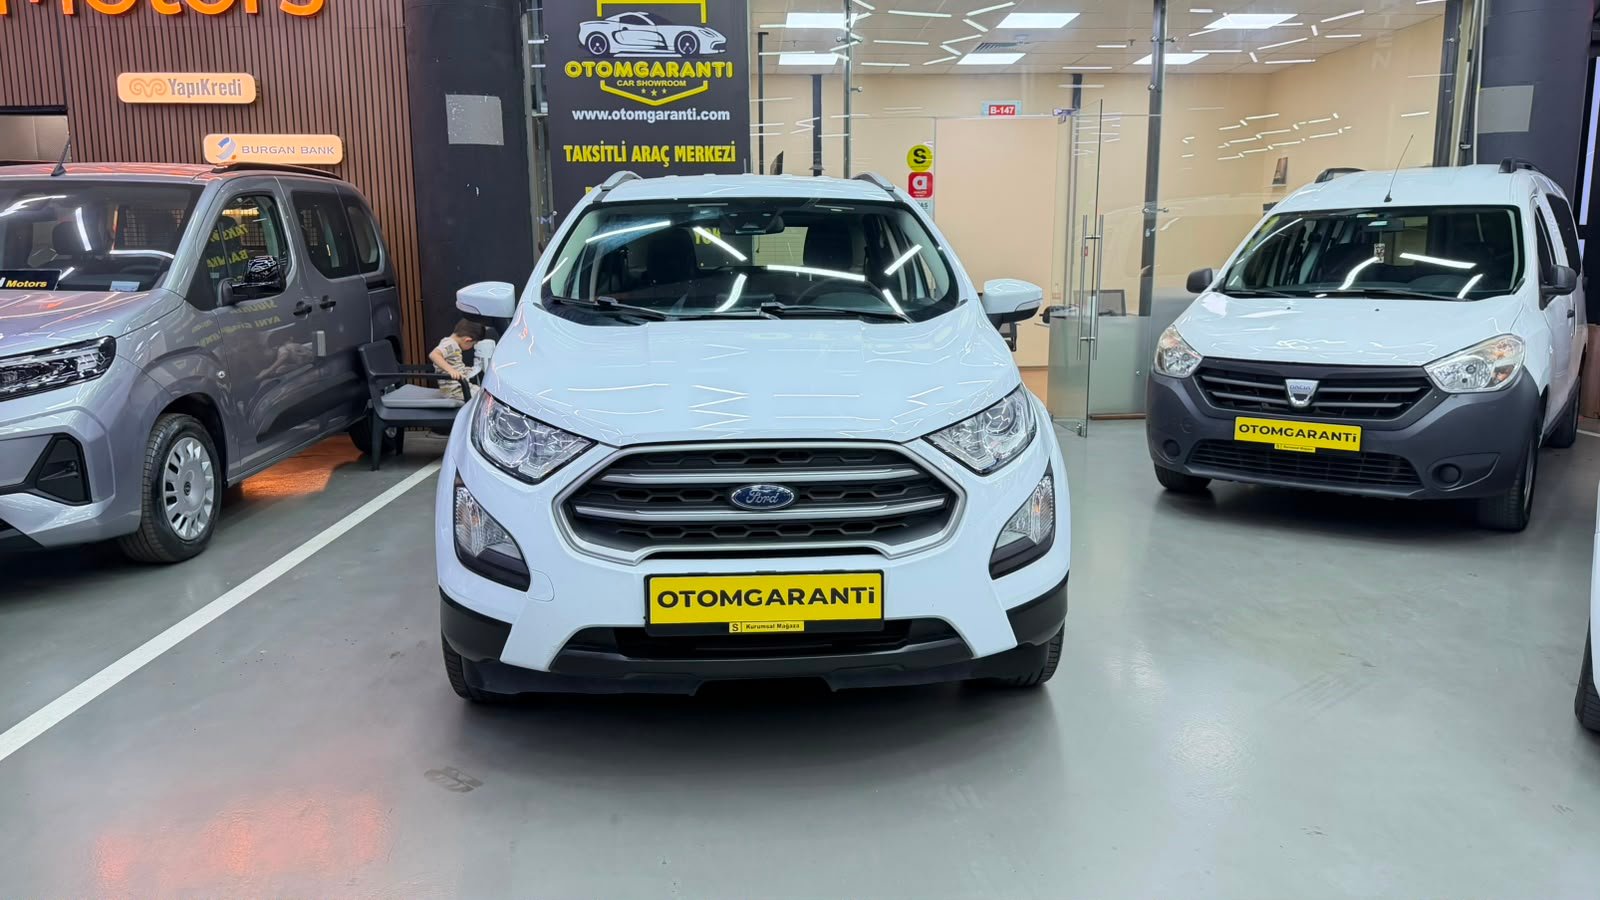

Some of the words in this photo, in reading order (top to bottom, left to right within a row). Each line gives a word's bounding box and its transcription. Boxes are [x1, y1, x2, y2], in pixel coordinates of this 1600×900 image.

[564, 60, 734, 79] OTOMGARANTI
[571, 107, 730, 123] www.otomgaranti.com
[990, 106, 1014, 114] B-147
[241, 145, 295, 154] BURGAN
[300, 146, 334, 154] BANK
[563, 140, 627, 162] TAKSİTLİ
[631, 145, 669, 167] ARAÇ
[675, 140, 736, 162] MERKEZİ
[913, 148, 927, 164] S
[6, 280, 47, 288] Motors
[745, 491, 780, 504] Ford
[657, 587, 875, 609] OTOMGARANTi
[732, 623, 739, 632] S
